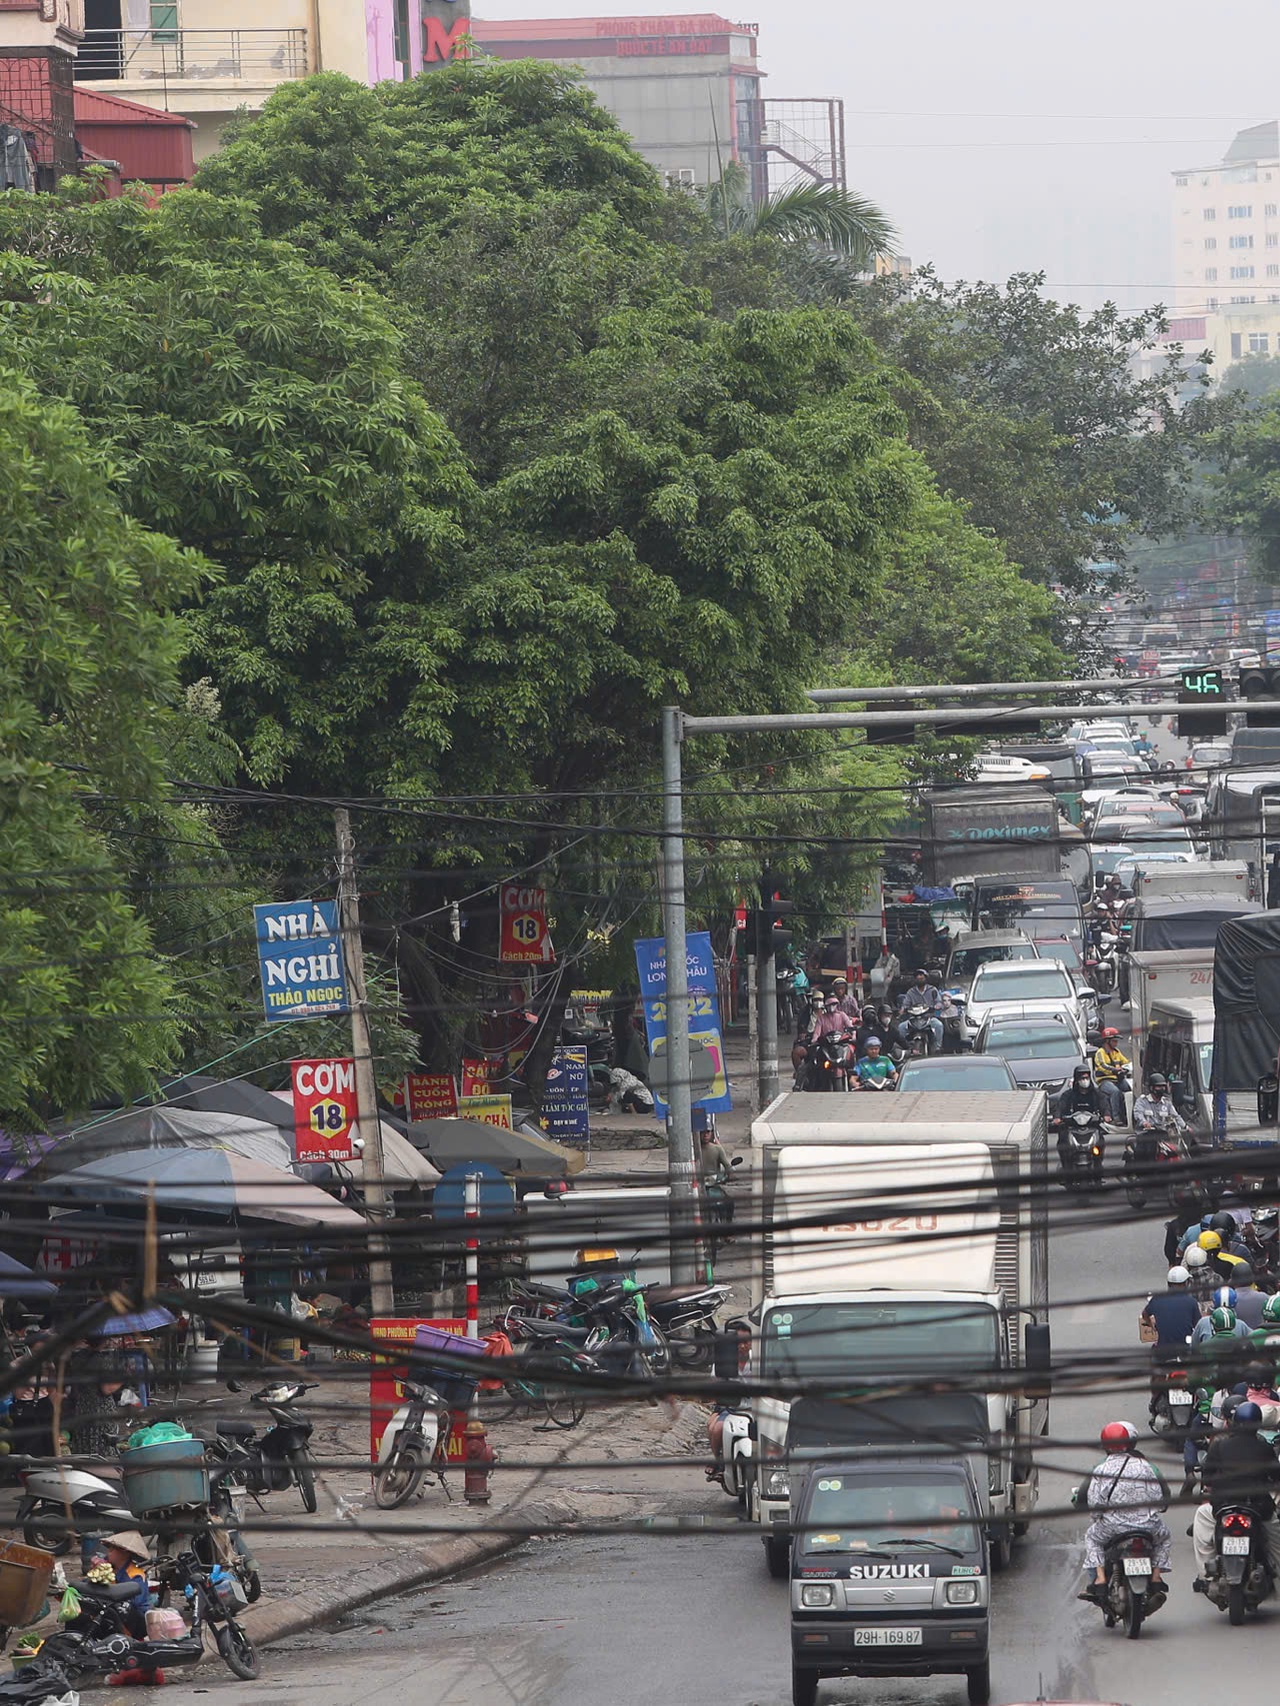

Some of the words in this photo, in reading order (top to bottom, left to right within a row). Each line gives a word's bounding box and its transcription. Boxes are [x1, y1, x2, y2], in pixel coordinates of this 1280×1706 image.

[265, 905, 331, 943] NHÀ
[515, 919, 536, 939] 18
[265, 943, 341, 986] NGHỈ
[268, 987, 302, 1007] THẢO
[306, 986, 343, 1003] NGỌC
[296, 1062, 354, 1096] CƠM
[312, 1104, 342, 1130] 18
[299, 1149, 325, 1160] Cách
[328, 1149, 349, 1159] 30m
[850, 1564, 930, 1579] SUZUKI
[856, 1631, 920, 1645] 29H-169.87
